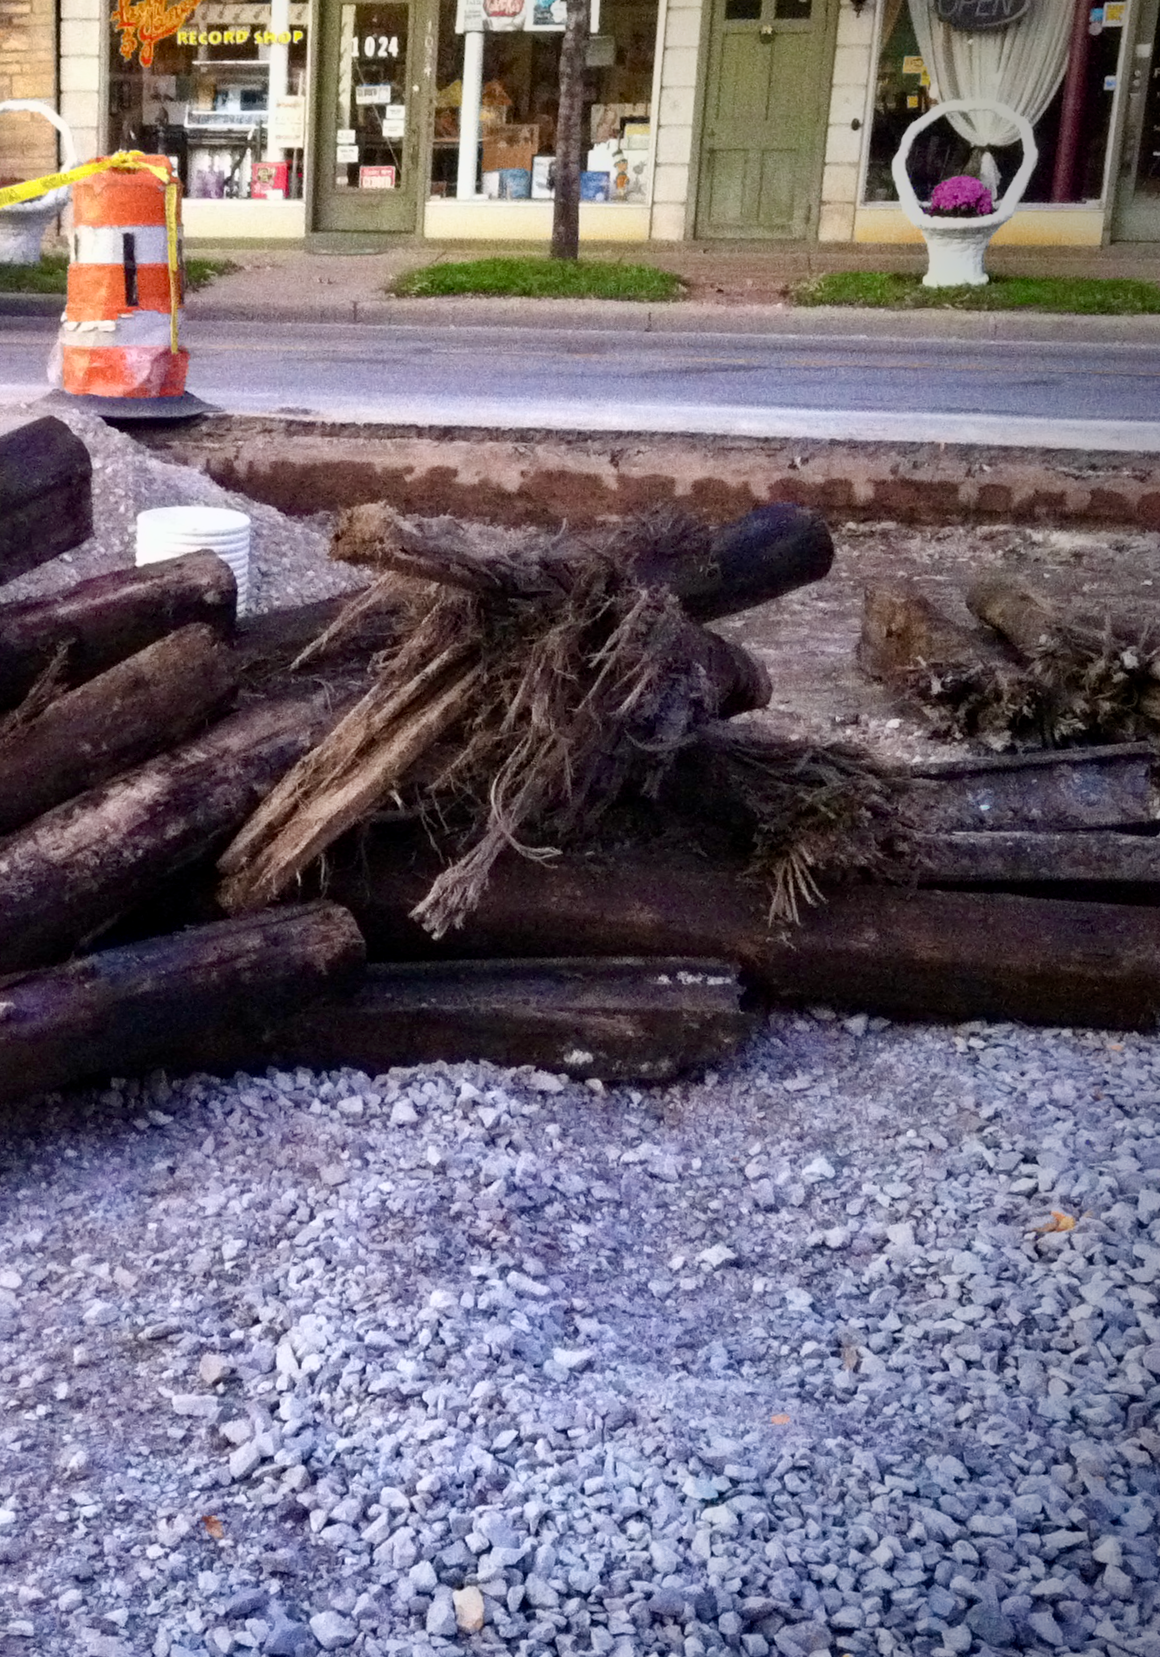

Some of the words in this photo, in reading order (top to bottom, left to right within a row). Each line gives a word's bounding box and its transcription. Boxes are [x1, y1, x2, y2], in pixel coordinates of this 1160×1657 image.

[176, 30, 248, 45] RECORD
[253, 30, 305, 45] SHOP
[351, 36, 399, 57] 1024
